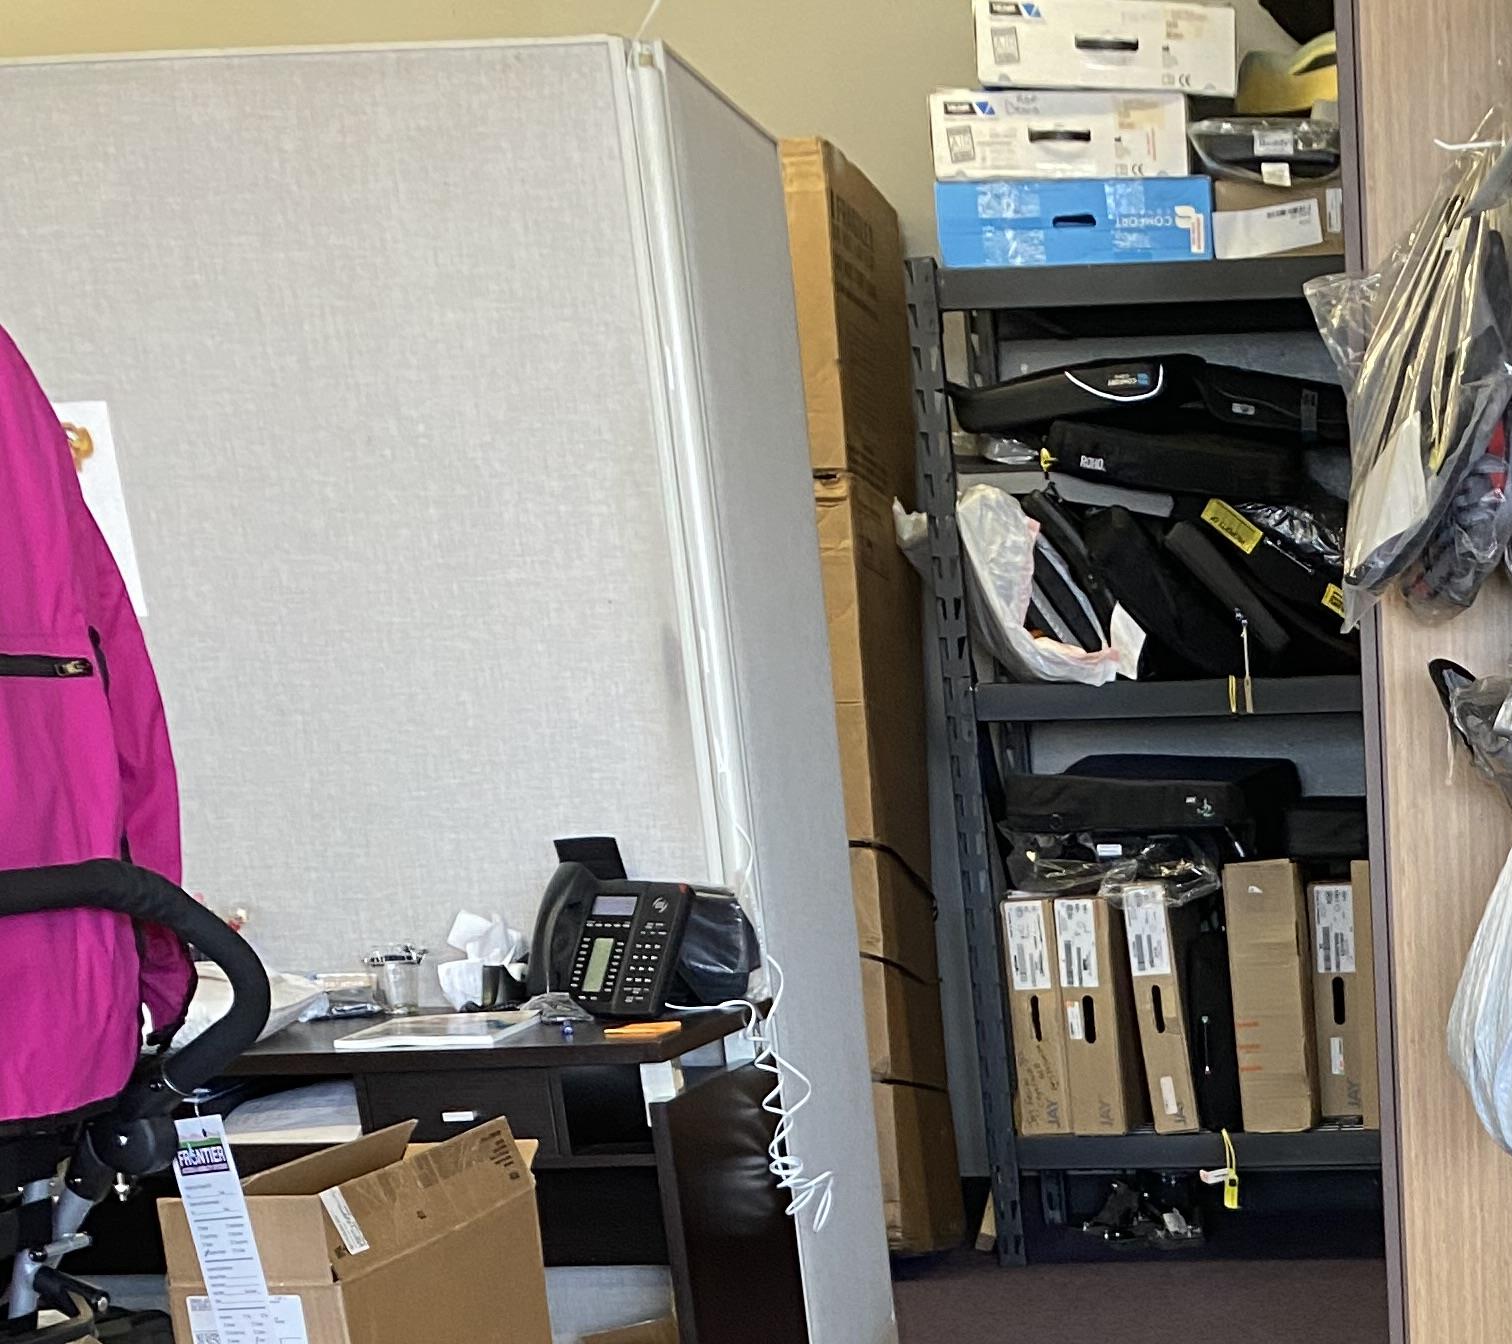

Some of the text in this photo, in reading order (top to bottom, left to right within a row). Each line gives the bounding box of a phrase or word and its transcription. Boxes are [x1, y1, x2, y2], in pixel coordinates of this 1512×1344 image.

[1347, 1077, 1361, 1108] JAY
[1046, 1098, 1060, 1129] JAY
[1099, 1099, 1115, 1127] JAY
[177, 1145, 227, 1167] FRONTIER
